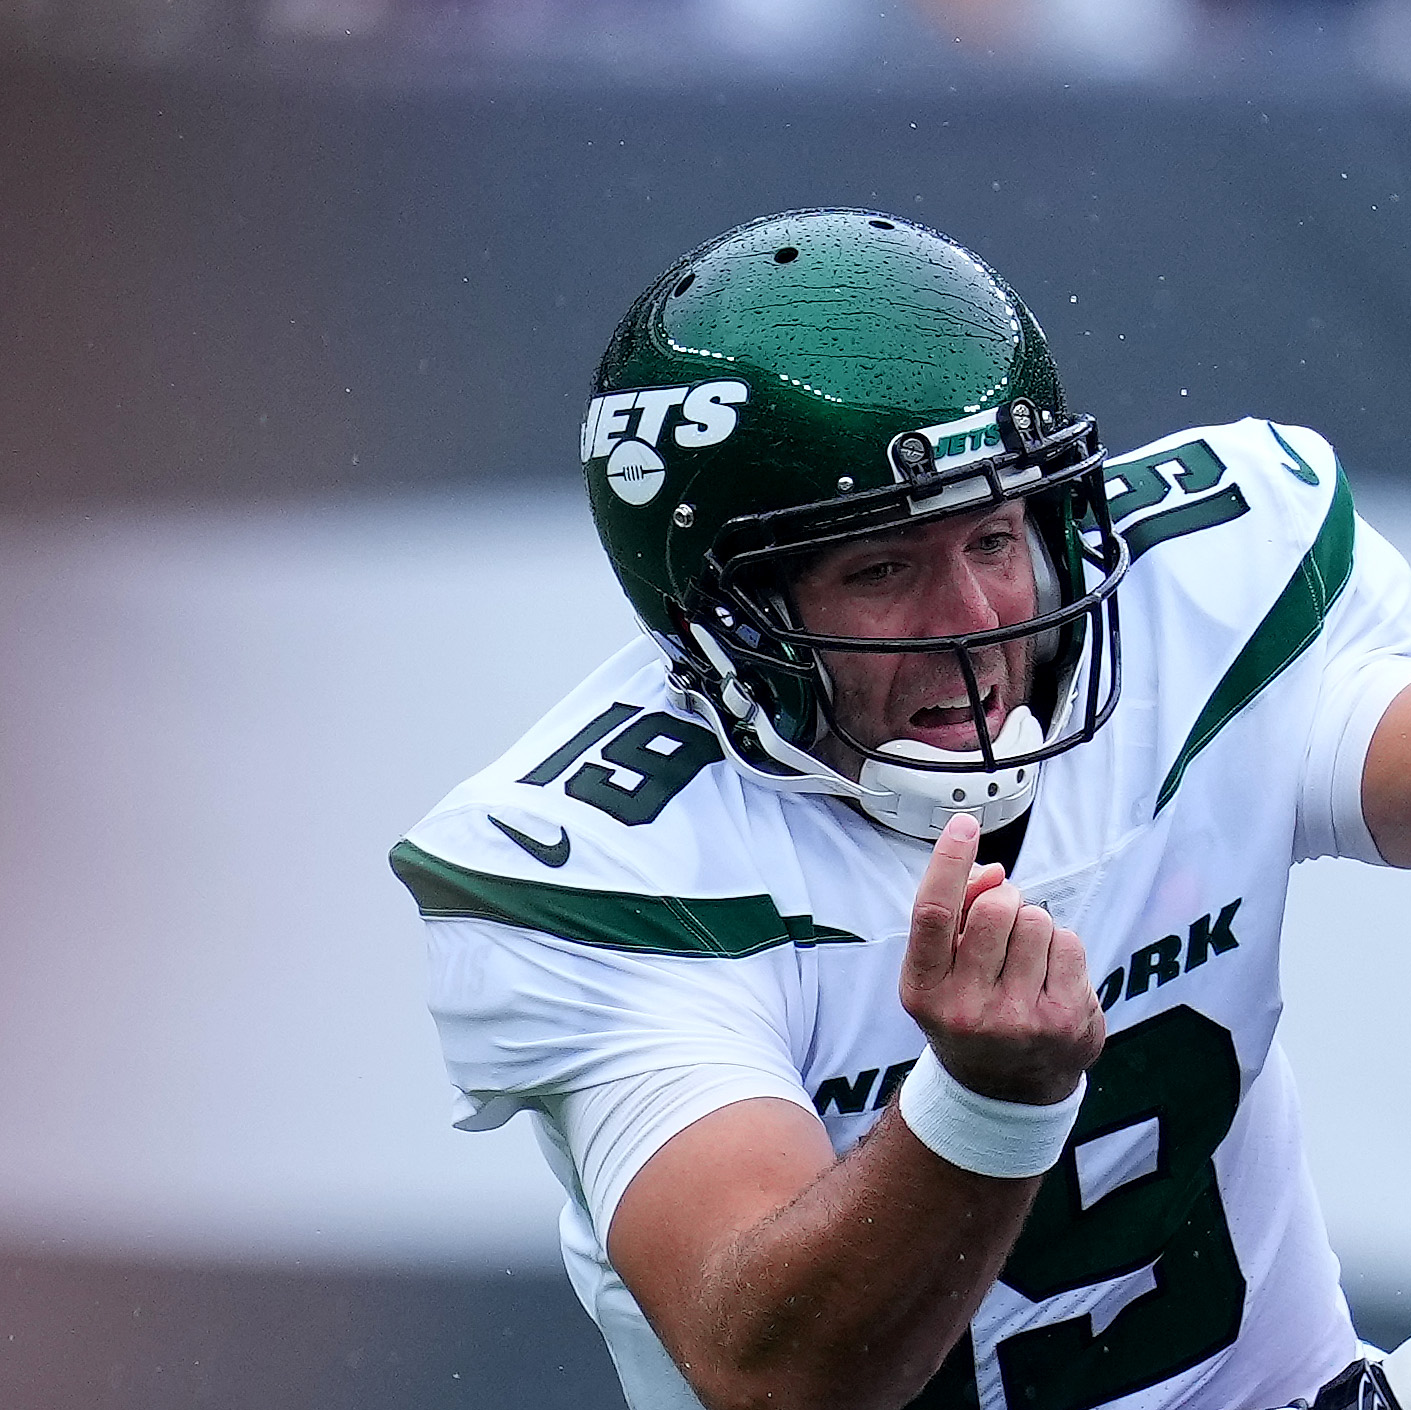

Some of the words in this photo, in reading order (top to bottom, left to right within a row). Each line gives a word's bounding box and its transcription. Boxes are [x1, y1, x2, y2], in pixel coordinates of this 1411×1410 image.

[580, 377, 750, 464] JETS
[933, 422, 1001, 461] JETS
[1090, 437, 1252, 567] 19
[512, 700, 727, 827] 19
[1095, 896, 1244, 1014] ORK
